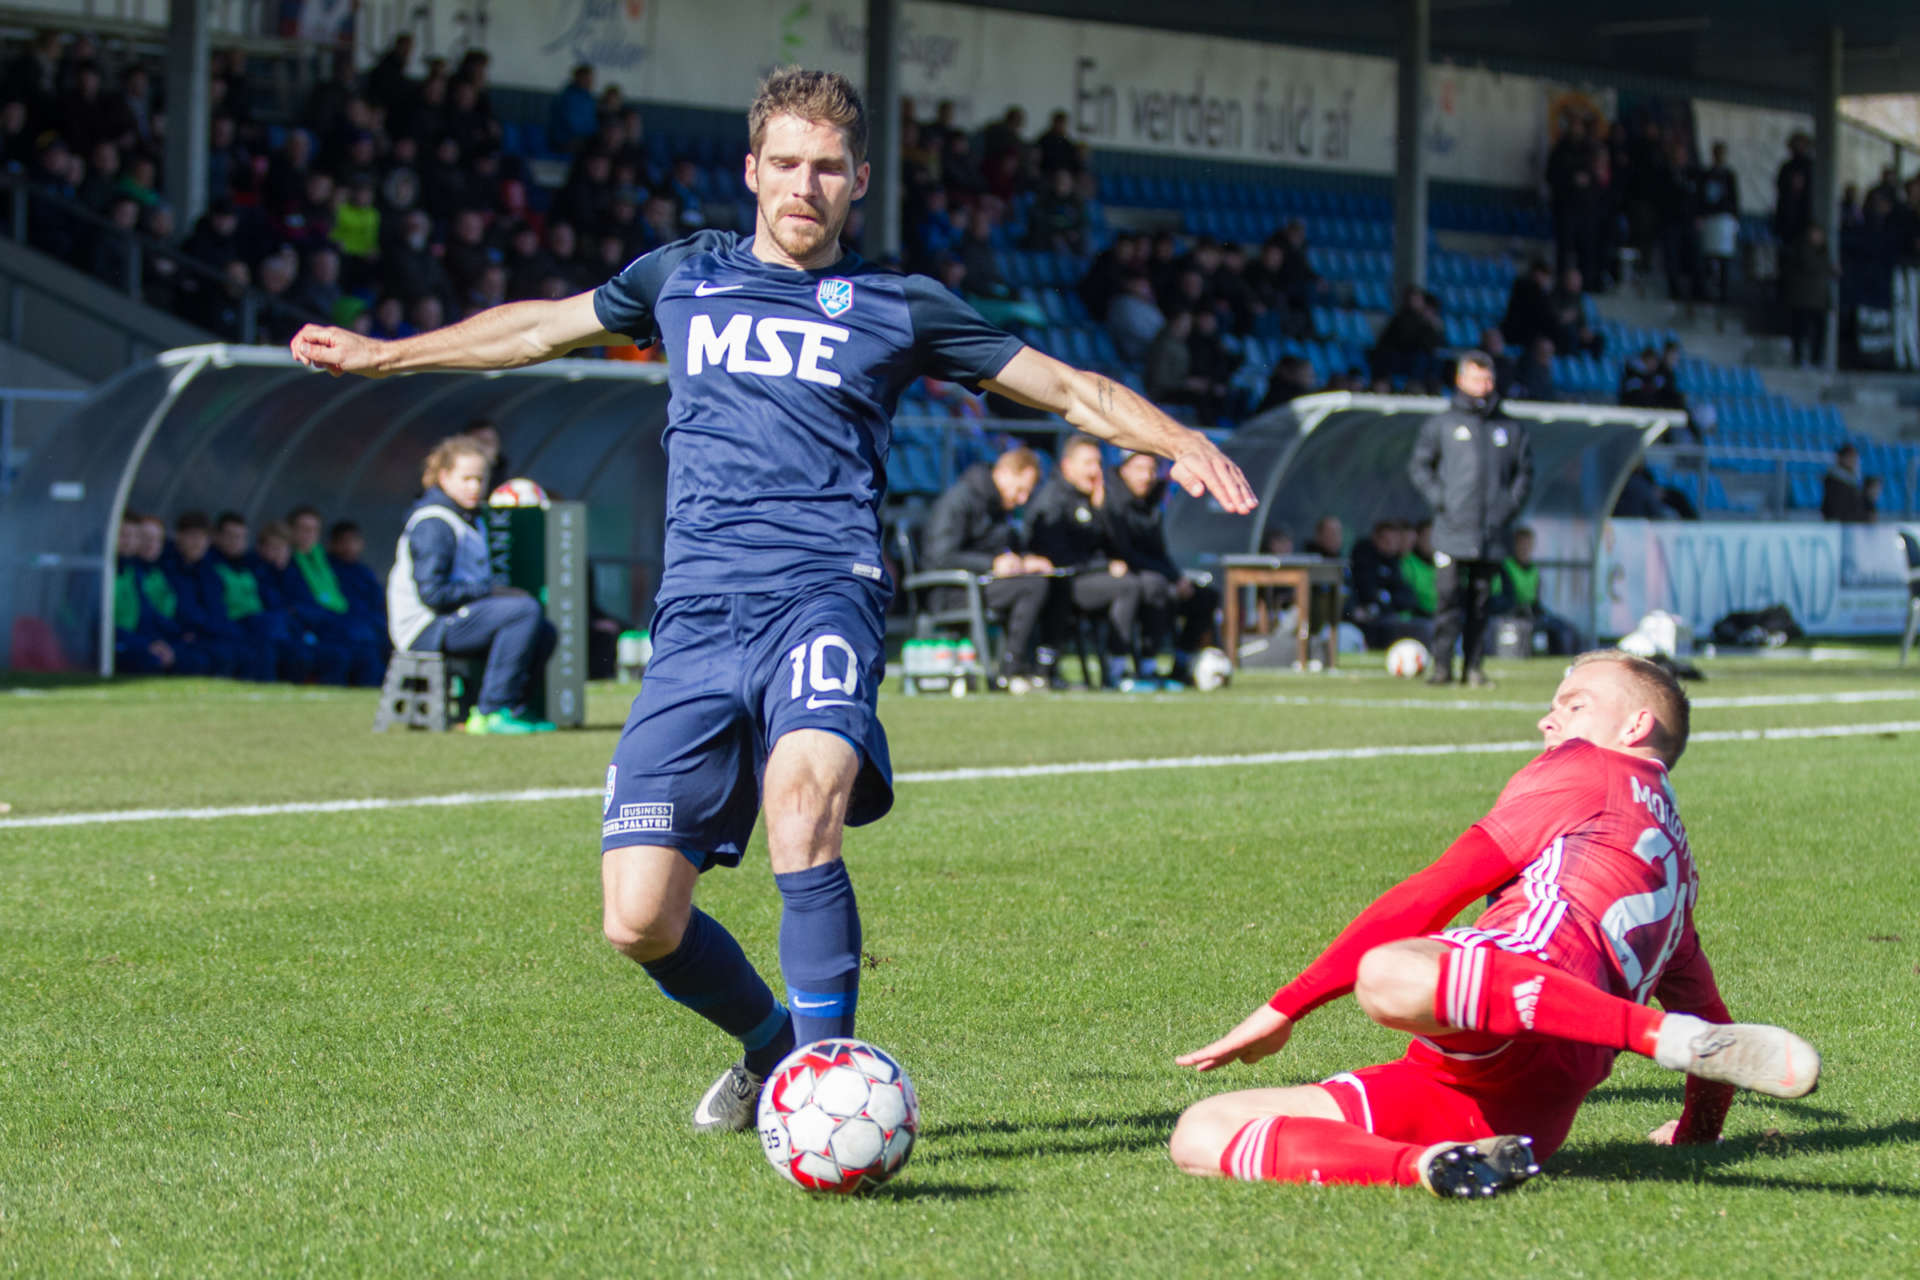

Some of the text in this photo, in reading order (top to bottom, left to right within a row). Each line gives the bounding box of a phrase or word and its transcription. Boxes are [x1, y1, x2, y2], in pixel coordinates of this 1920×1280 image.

[1074, 57, 1119, 135] En
[1130, 70, 1243, 148] verden
[1254, 78, 1317, 157] fuld
[1322, 88, 1356, 160] af
[687, 313, 850, 388] MSE
[789, 634, 858, 700] 10
[623, 806, 669, 817] BUSINESS
